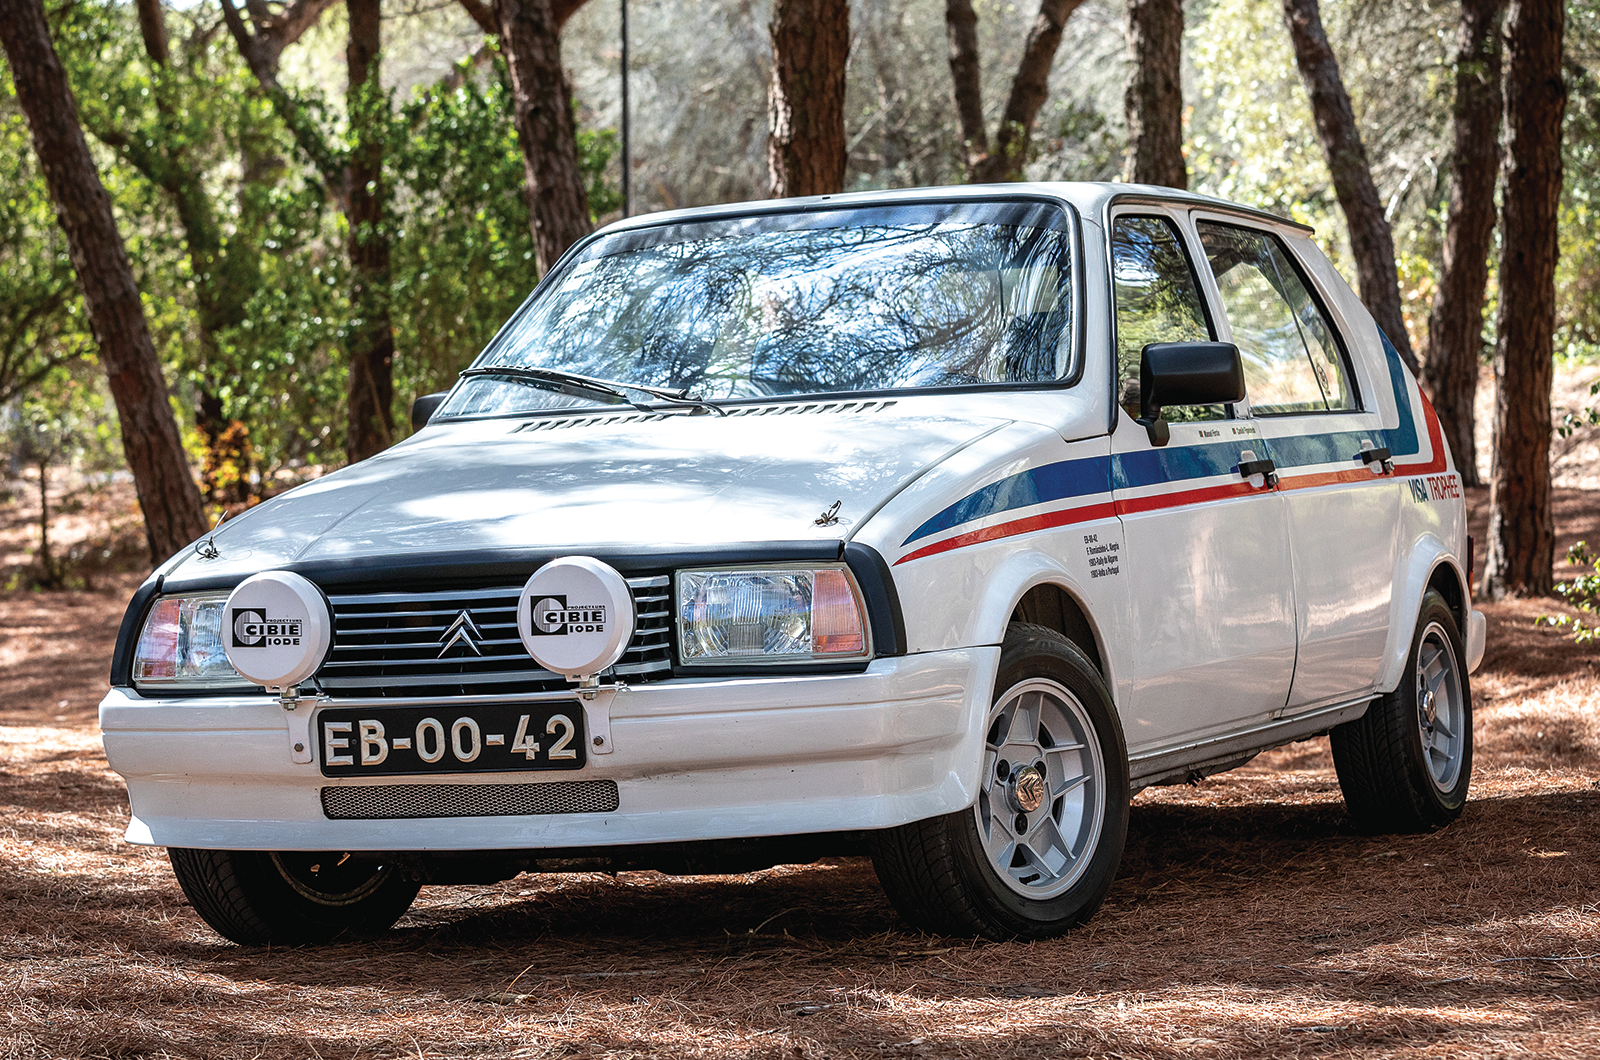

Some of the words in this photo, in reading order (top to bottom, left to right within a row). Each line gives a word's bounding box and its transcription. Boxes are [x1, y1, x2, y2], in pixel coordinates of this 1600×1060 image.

[1408, 478, 1429, 503] VISA
[1426, 474, 1460, 500] TROPHEE
[1084, 534, 1098, 544] EB-00-42
[545, 611, 602, 622] CIBIE
[245, 625, 299, 636] CIBIE
[569, 625, 604, 633] IODE
[268, 638, 300, 646] IODE
[324, 713, 577, 767] EB-00-42
